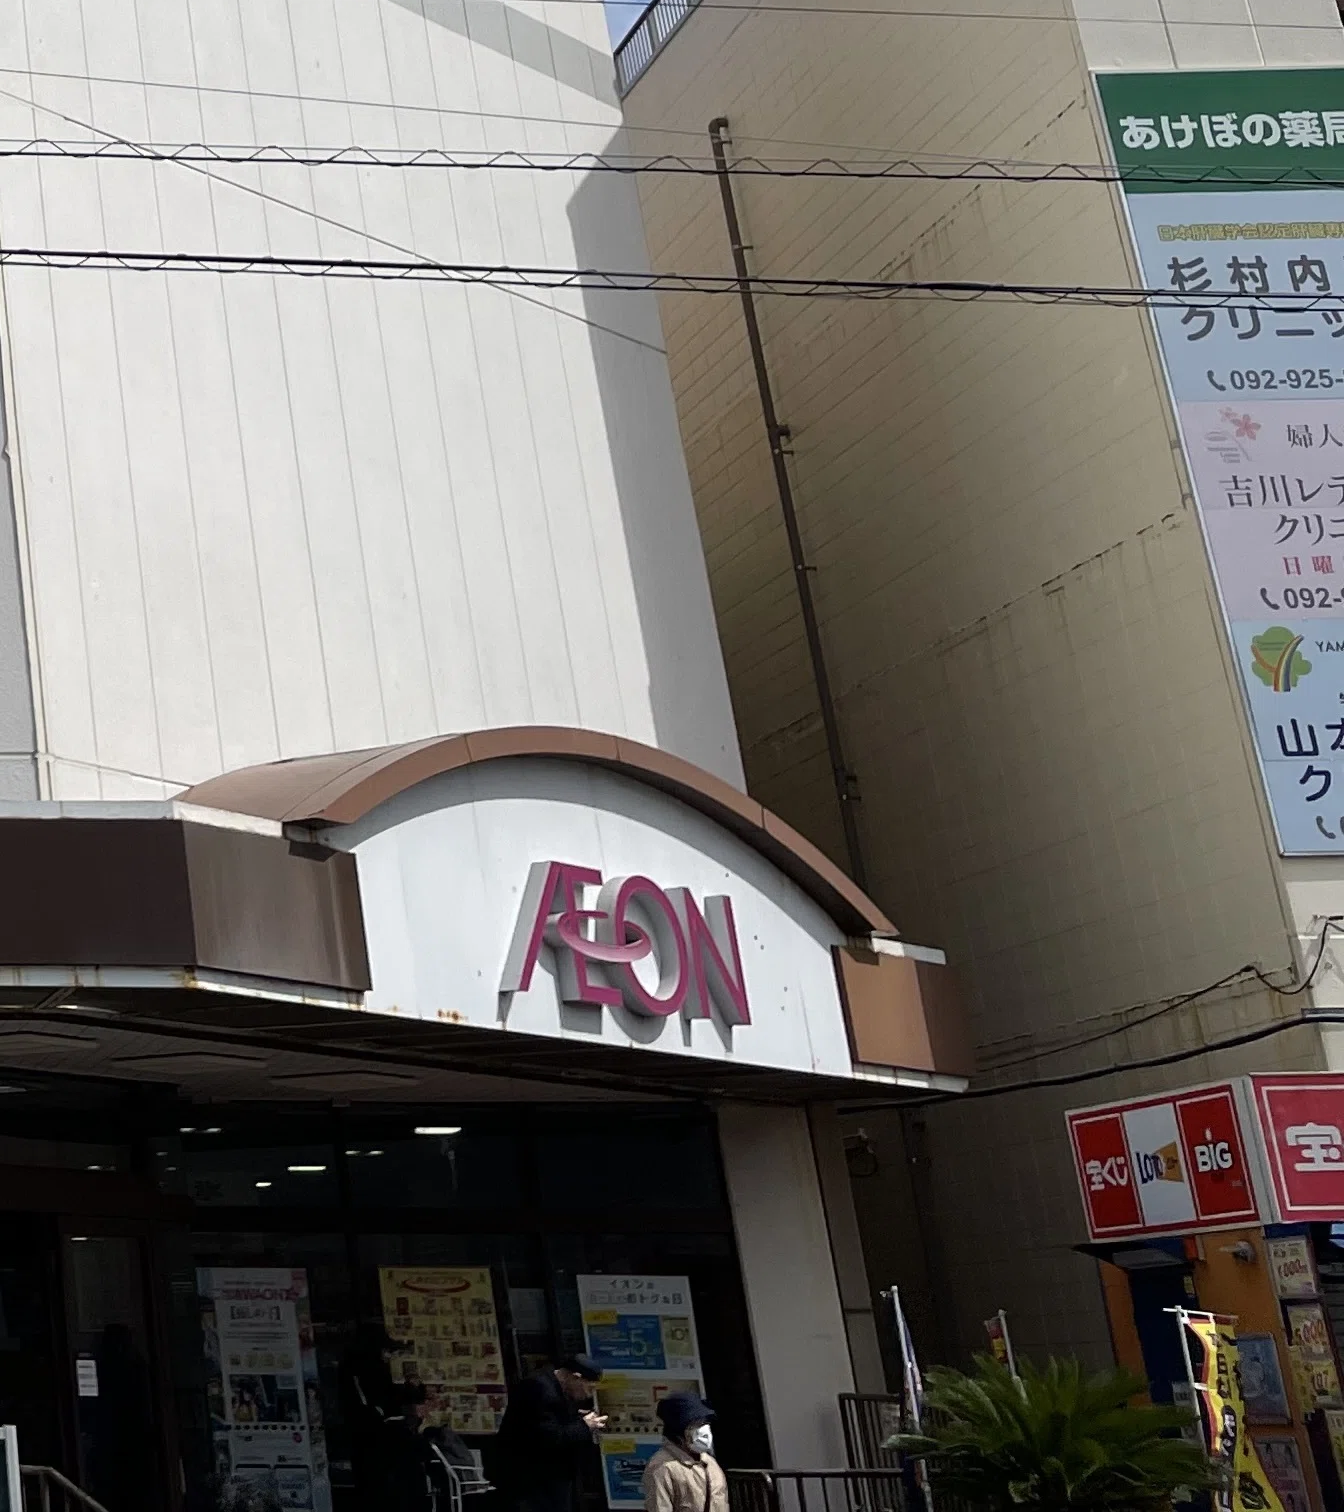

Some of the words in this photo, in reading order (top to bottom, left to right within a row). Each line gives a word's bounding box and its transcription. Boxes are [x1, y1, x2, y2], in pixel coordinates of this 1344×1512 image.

[1157, 222, 1344, 242] 日本肝臓学会認定肝臓専
[1167, 254, 1344, 293] 杉村内
[1230, 369, 1344, 390] 092-925-
[1283, 554, 1344, 575] 日曜
[1284, 588, 1344, 609] 092-
[499, 861, 752, 1026] AEON
[1194, 1141, 1234, 1173] BIG
[1085, 1156, 1128, 1191] 宝くじ
